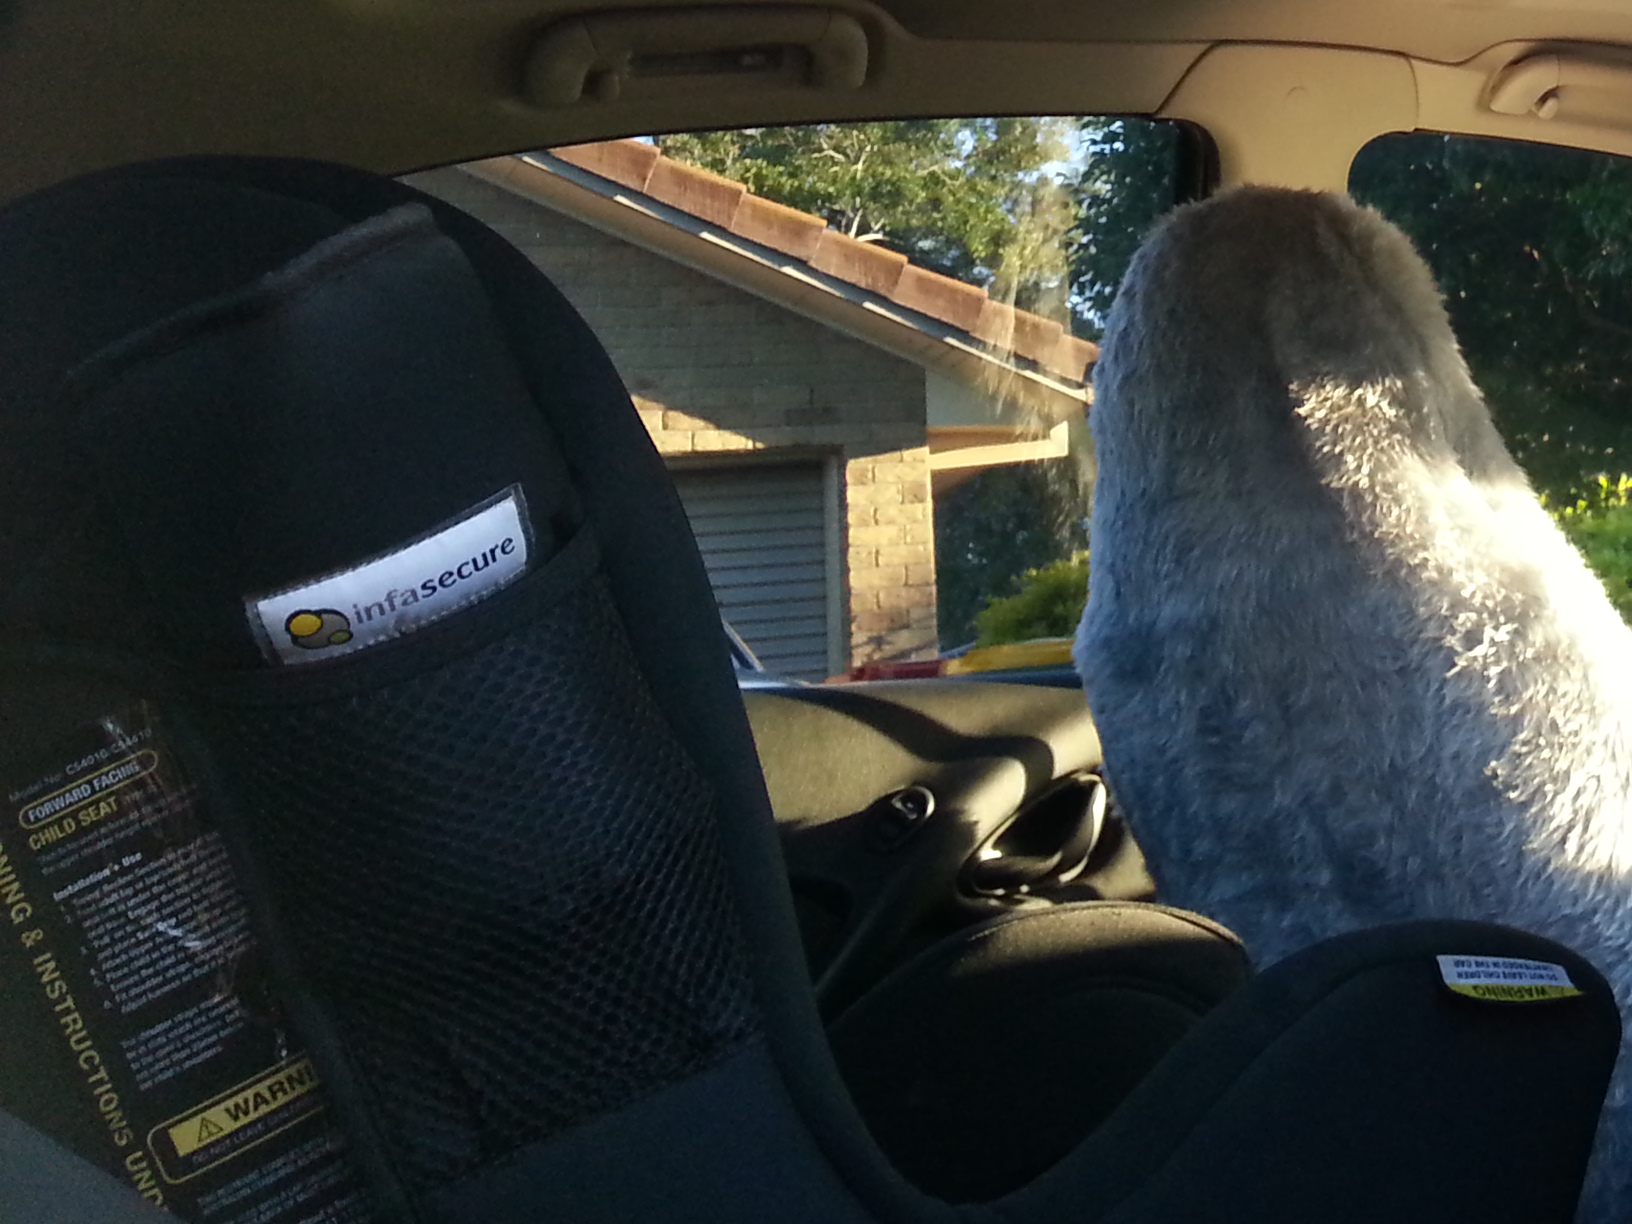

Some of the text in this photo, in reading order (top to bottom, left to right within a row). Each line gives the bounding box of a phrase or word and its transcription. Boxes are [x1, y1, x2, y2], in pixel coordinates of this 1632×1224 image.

[353, 537, 516, 624] infasecure
[27, 782, 92, 822] FORWARD
[92, 759, 140, 791] FACING
[27, 815, 77, 851] CHILD
[76, 795, 120, 827] SEAT
[1456, 970, 1501, 980] CHILDREN
[19, 925, 46, 949] &
[33, 952, 135, 1148] INSTRUCTIONS
